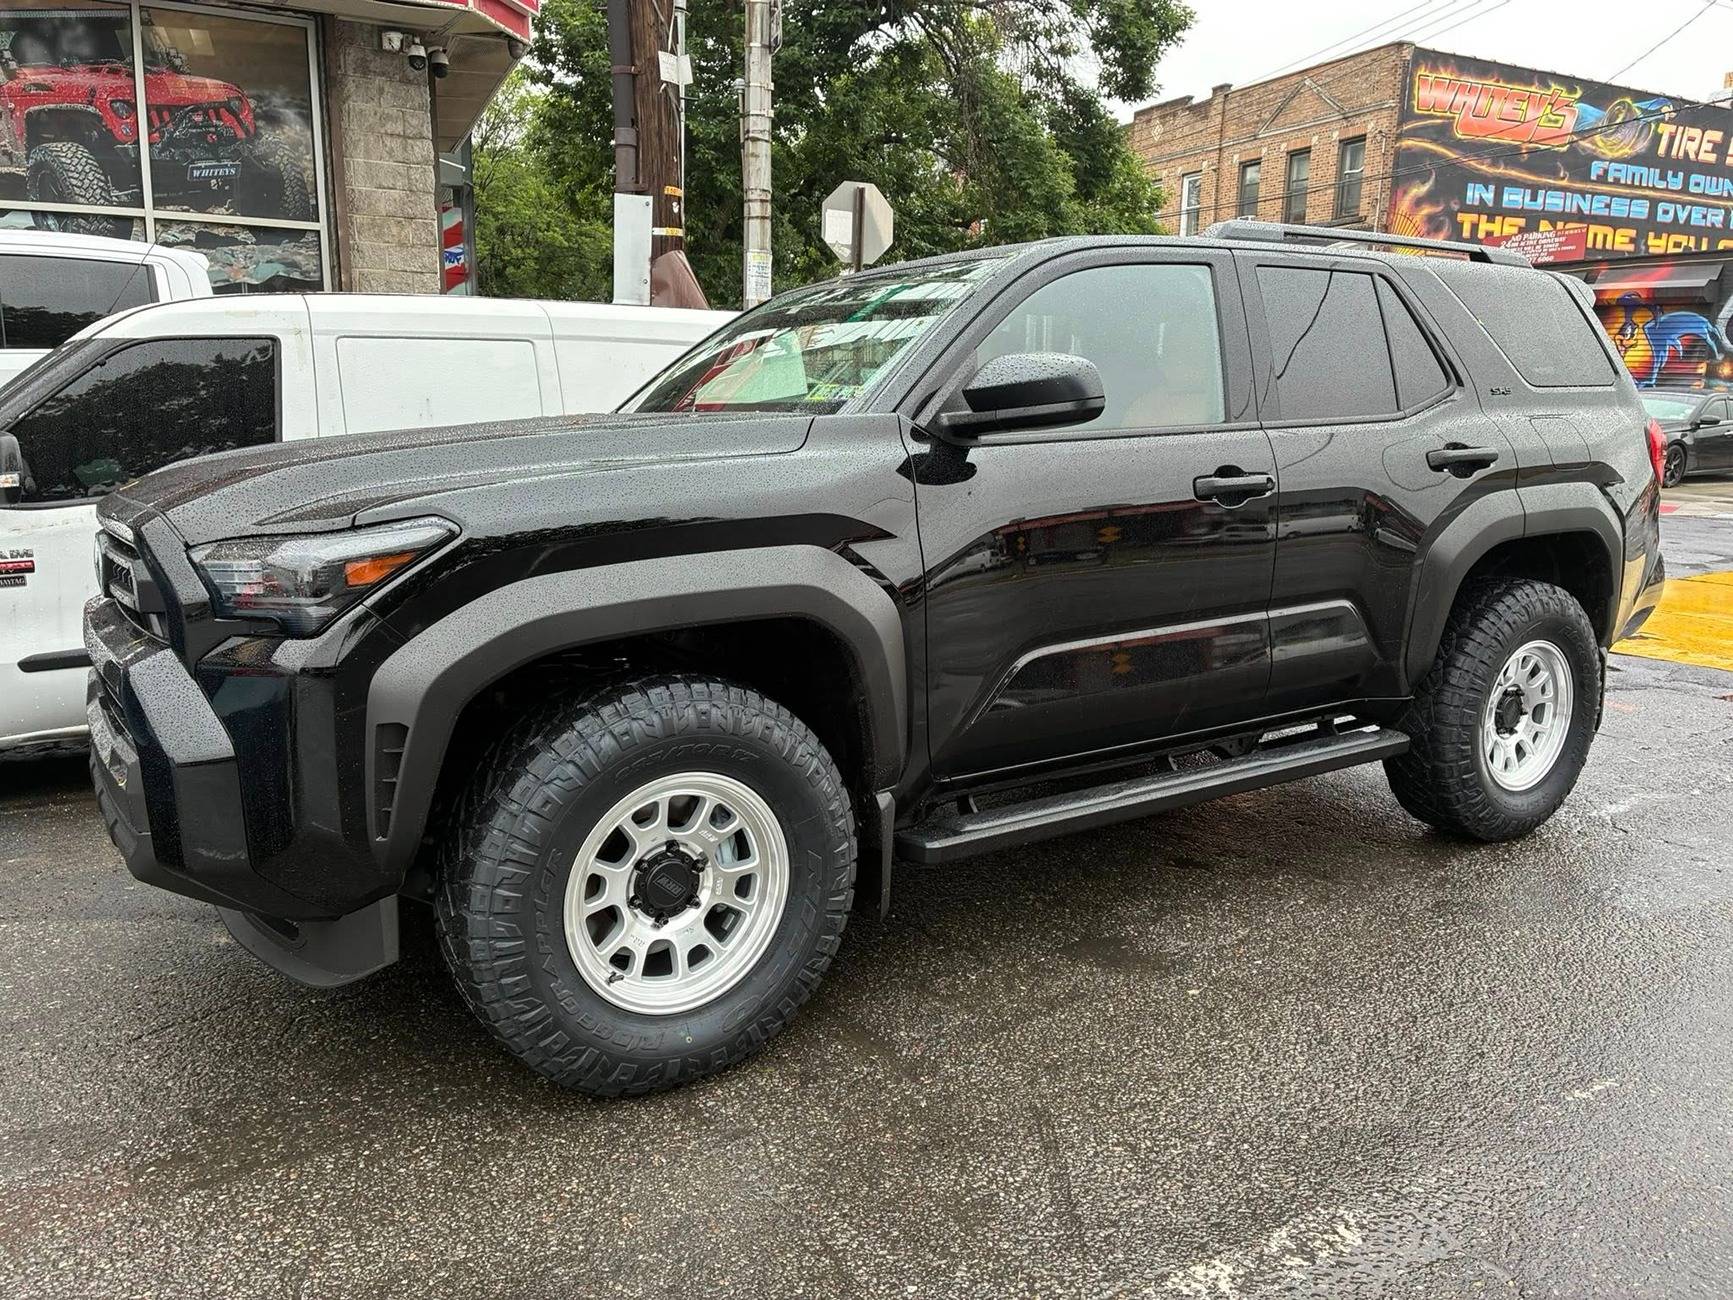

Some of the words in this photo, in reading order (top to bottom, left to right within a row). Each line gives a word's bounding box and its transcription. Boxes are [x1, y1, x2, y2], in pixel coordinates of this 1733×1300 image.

[1416, 74, 1579, 146] WHITEY'S
[1657, 122, 1723, 165] TIRE
[192, 167, 236, 178] WHITEYS
[1590, 160, 1684, 190] FAMILY
[1465, 182, 1495, 207] IN
[1502, 186, 1650, 219] BUSINESS
[1656, 202, 1724, 228] OVER
[1456, 212, 1526, 239] THE
